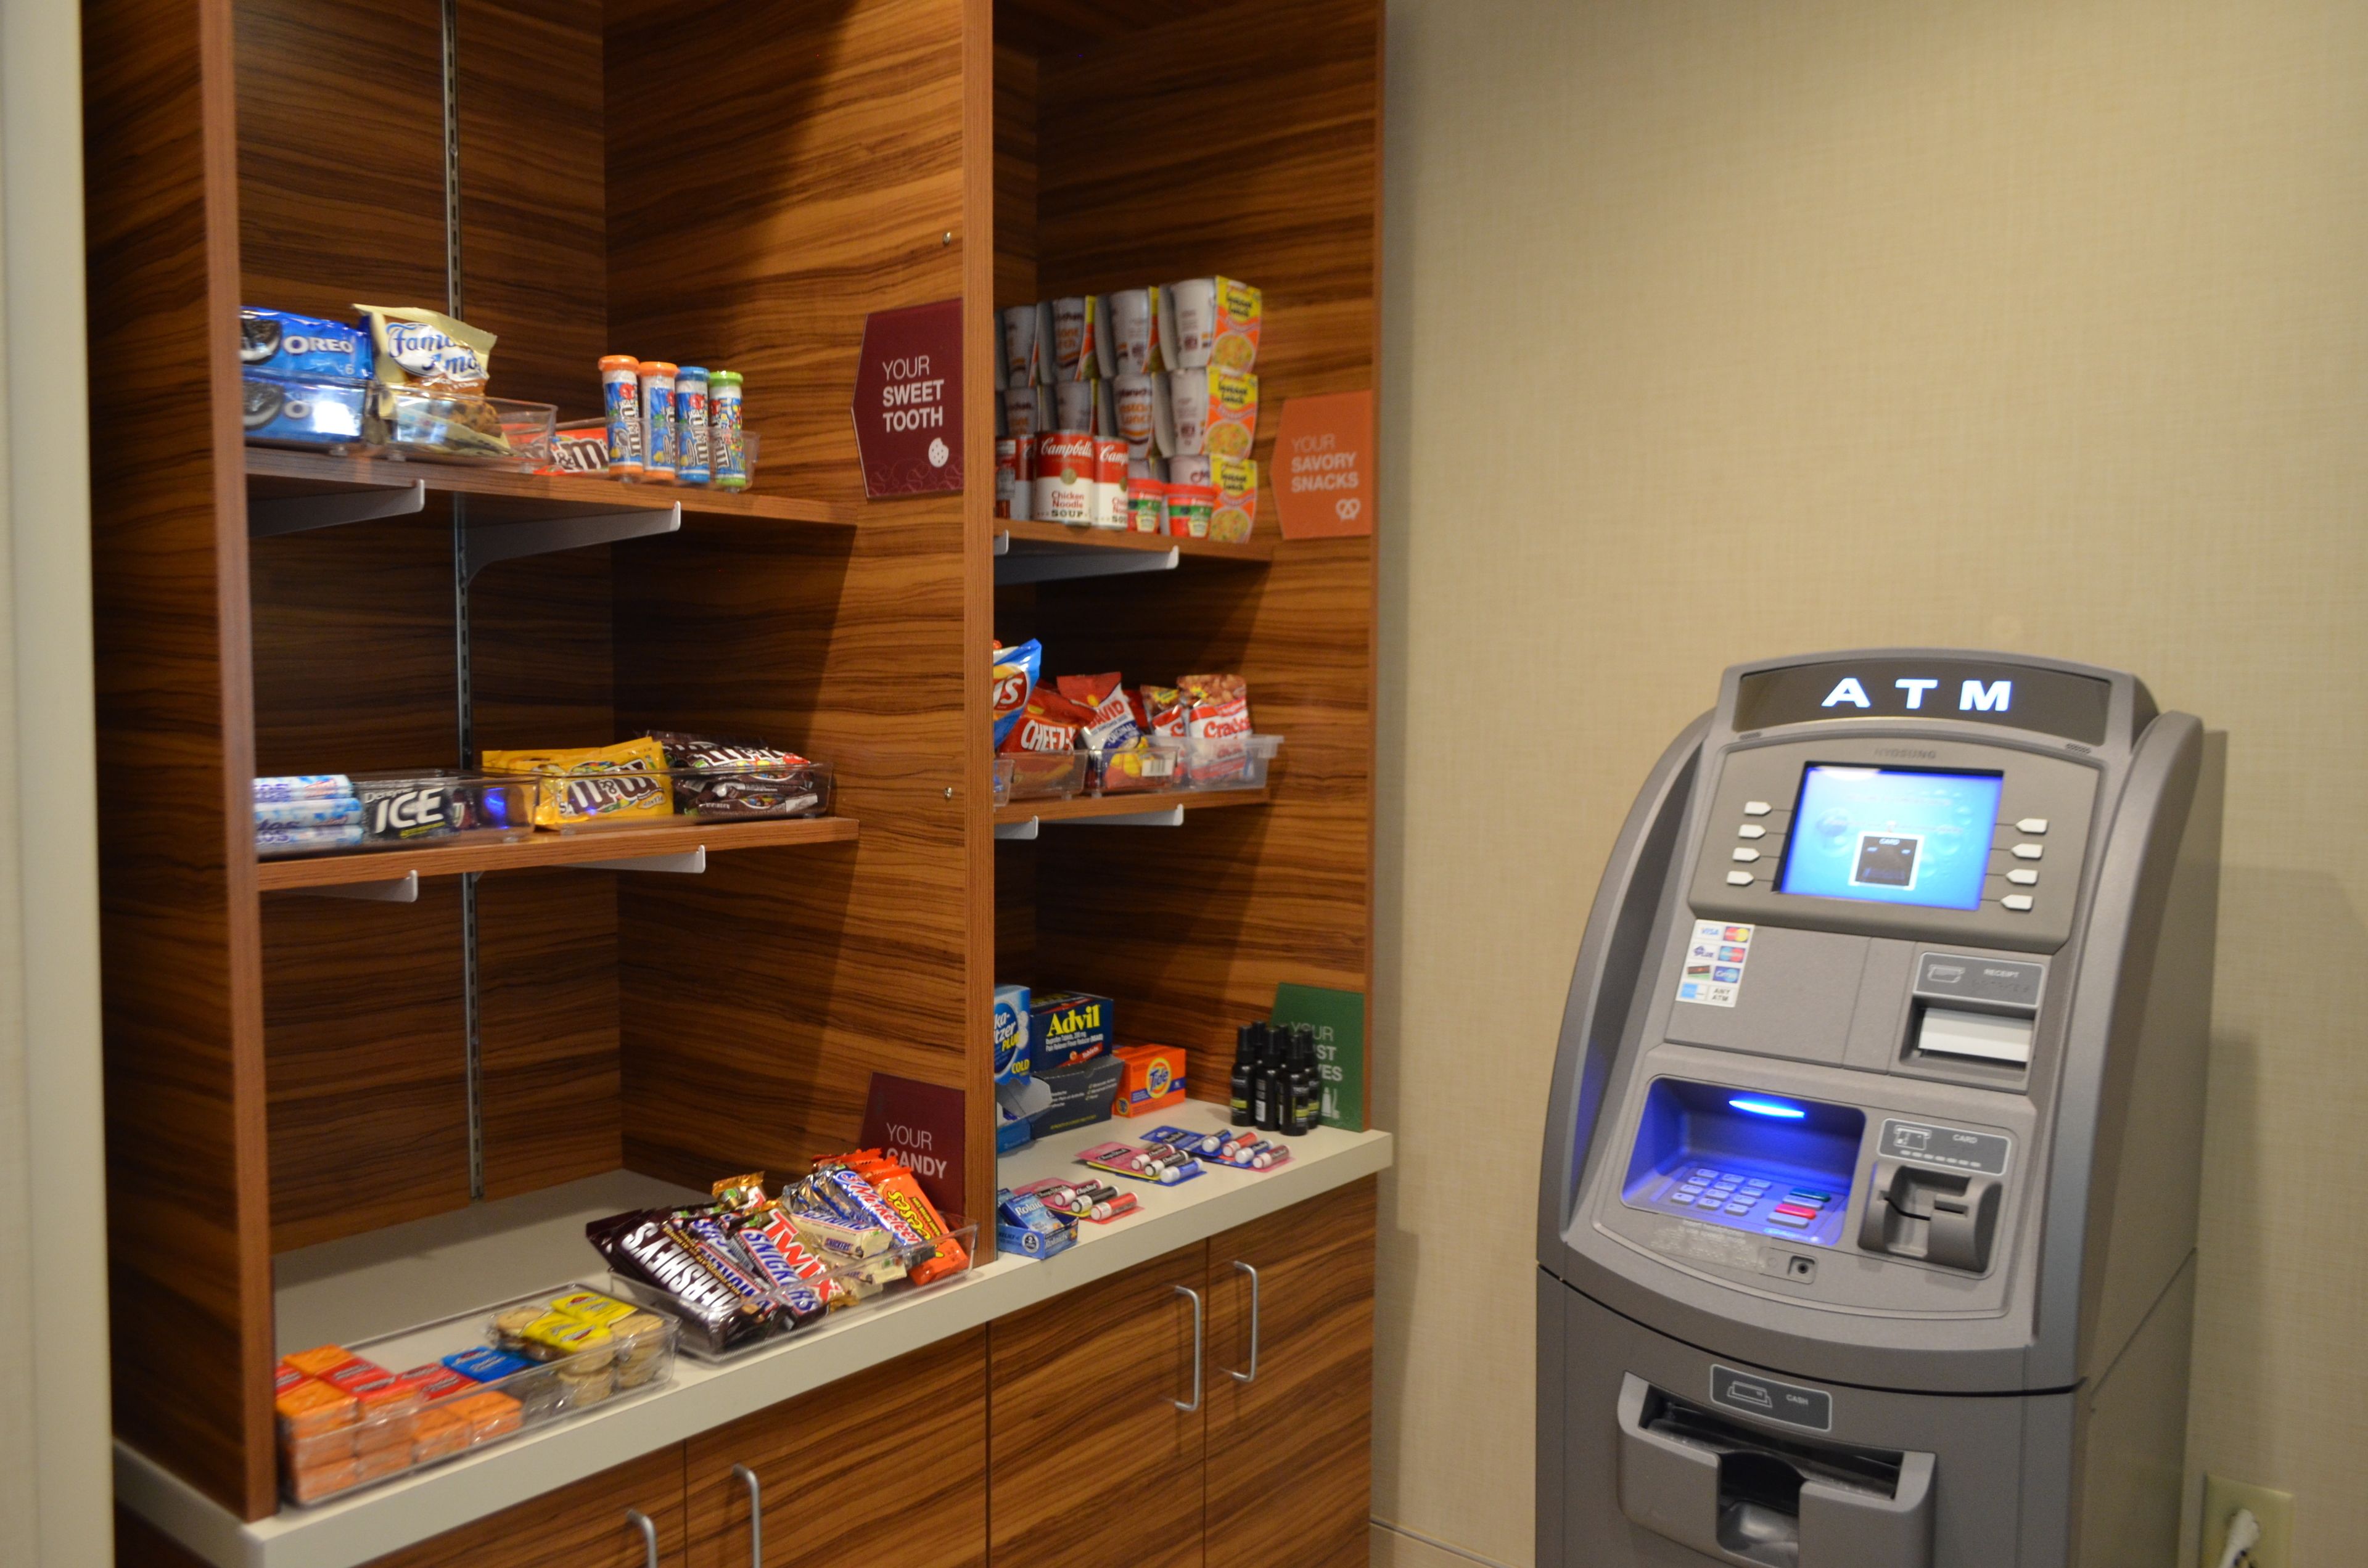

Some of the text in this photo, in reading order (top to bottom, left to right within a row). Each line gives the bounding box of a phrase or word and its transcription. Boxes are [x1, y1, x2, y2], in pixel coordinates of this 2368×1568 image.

[282, 335, 355, 355] OREO
[387, 322, 456, 359] Famo
[882, 355, 930, 381] YOUR
[882, 379, 945, 408] SWEET
[882, 405, 944, 433] TOOTH
[1291, 433, 1336, 453] YOUR
[1291, 451, 1357, 474] SAVORY
[1291, 471, 1359, 493] SNACKS
[1051, 490, 1084, 501] Chicken
[1052, 499, 1083, 509] Noodle
[1051, 509, 1083, 518] SOUP
[1820, 677, 2012, 712] ATM
[1873, 747, 1937, 760] HYOSUNG
[375, 787, 445, 834] ICE
[1983, 967, 2020, 979] RECEIPT
[994, 1012, 1011, 1029] ka-
[1046, 1003, 1101, 1037] Advil
[994, 1020, 1016, 1044] tzer
[1291, 1022, 1334, 1041] YUR
[1315, 1044, 1338, 1061] ST
[1011, 1059, 1030, 1074] COLD
[1149, 1067, 1170, 1092] Tide
[886, 1122, 932, 1151] YOUR
[1952, 1133, 1978, 1146] CARD
[886, 1147, 948, 1180] CANDY
[825, 1238, 852, 1252] SNICKERS
[1785, 1393, 1810, 1407] CASH
